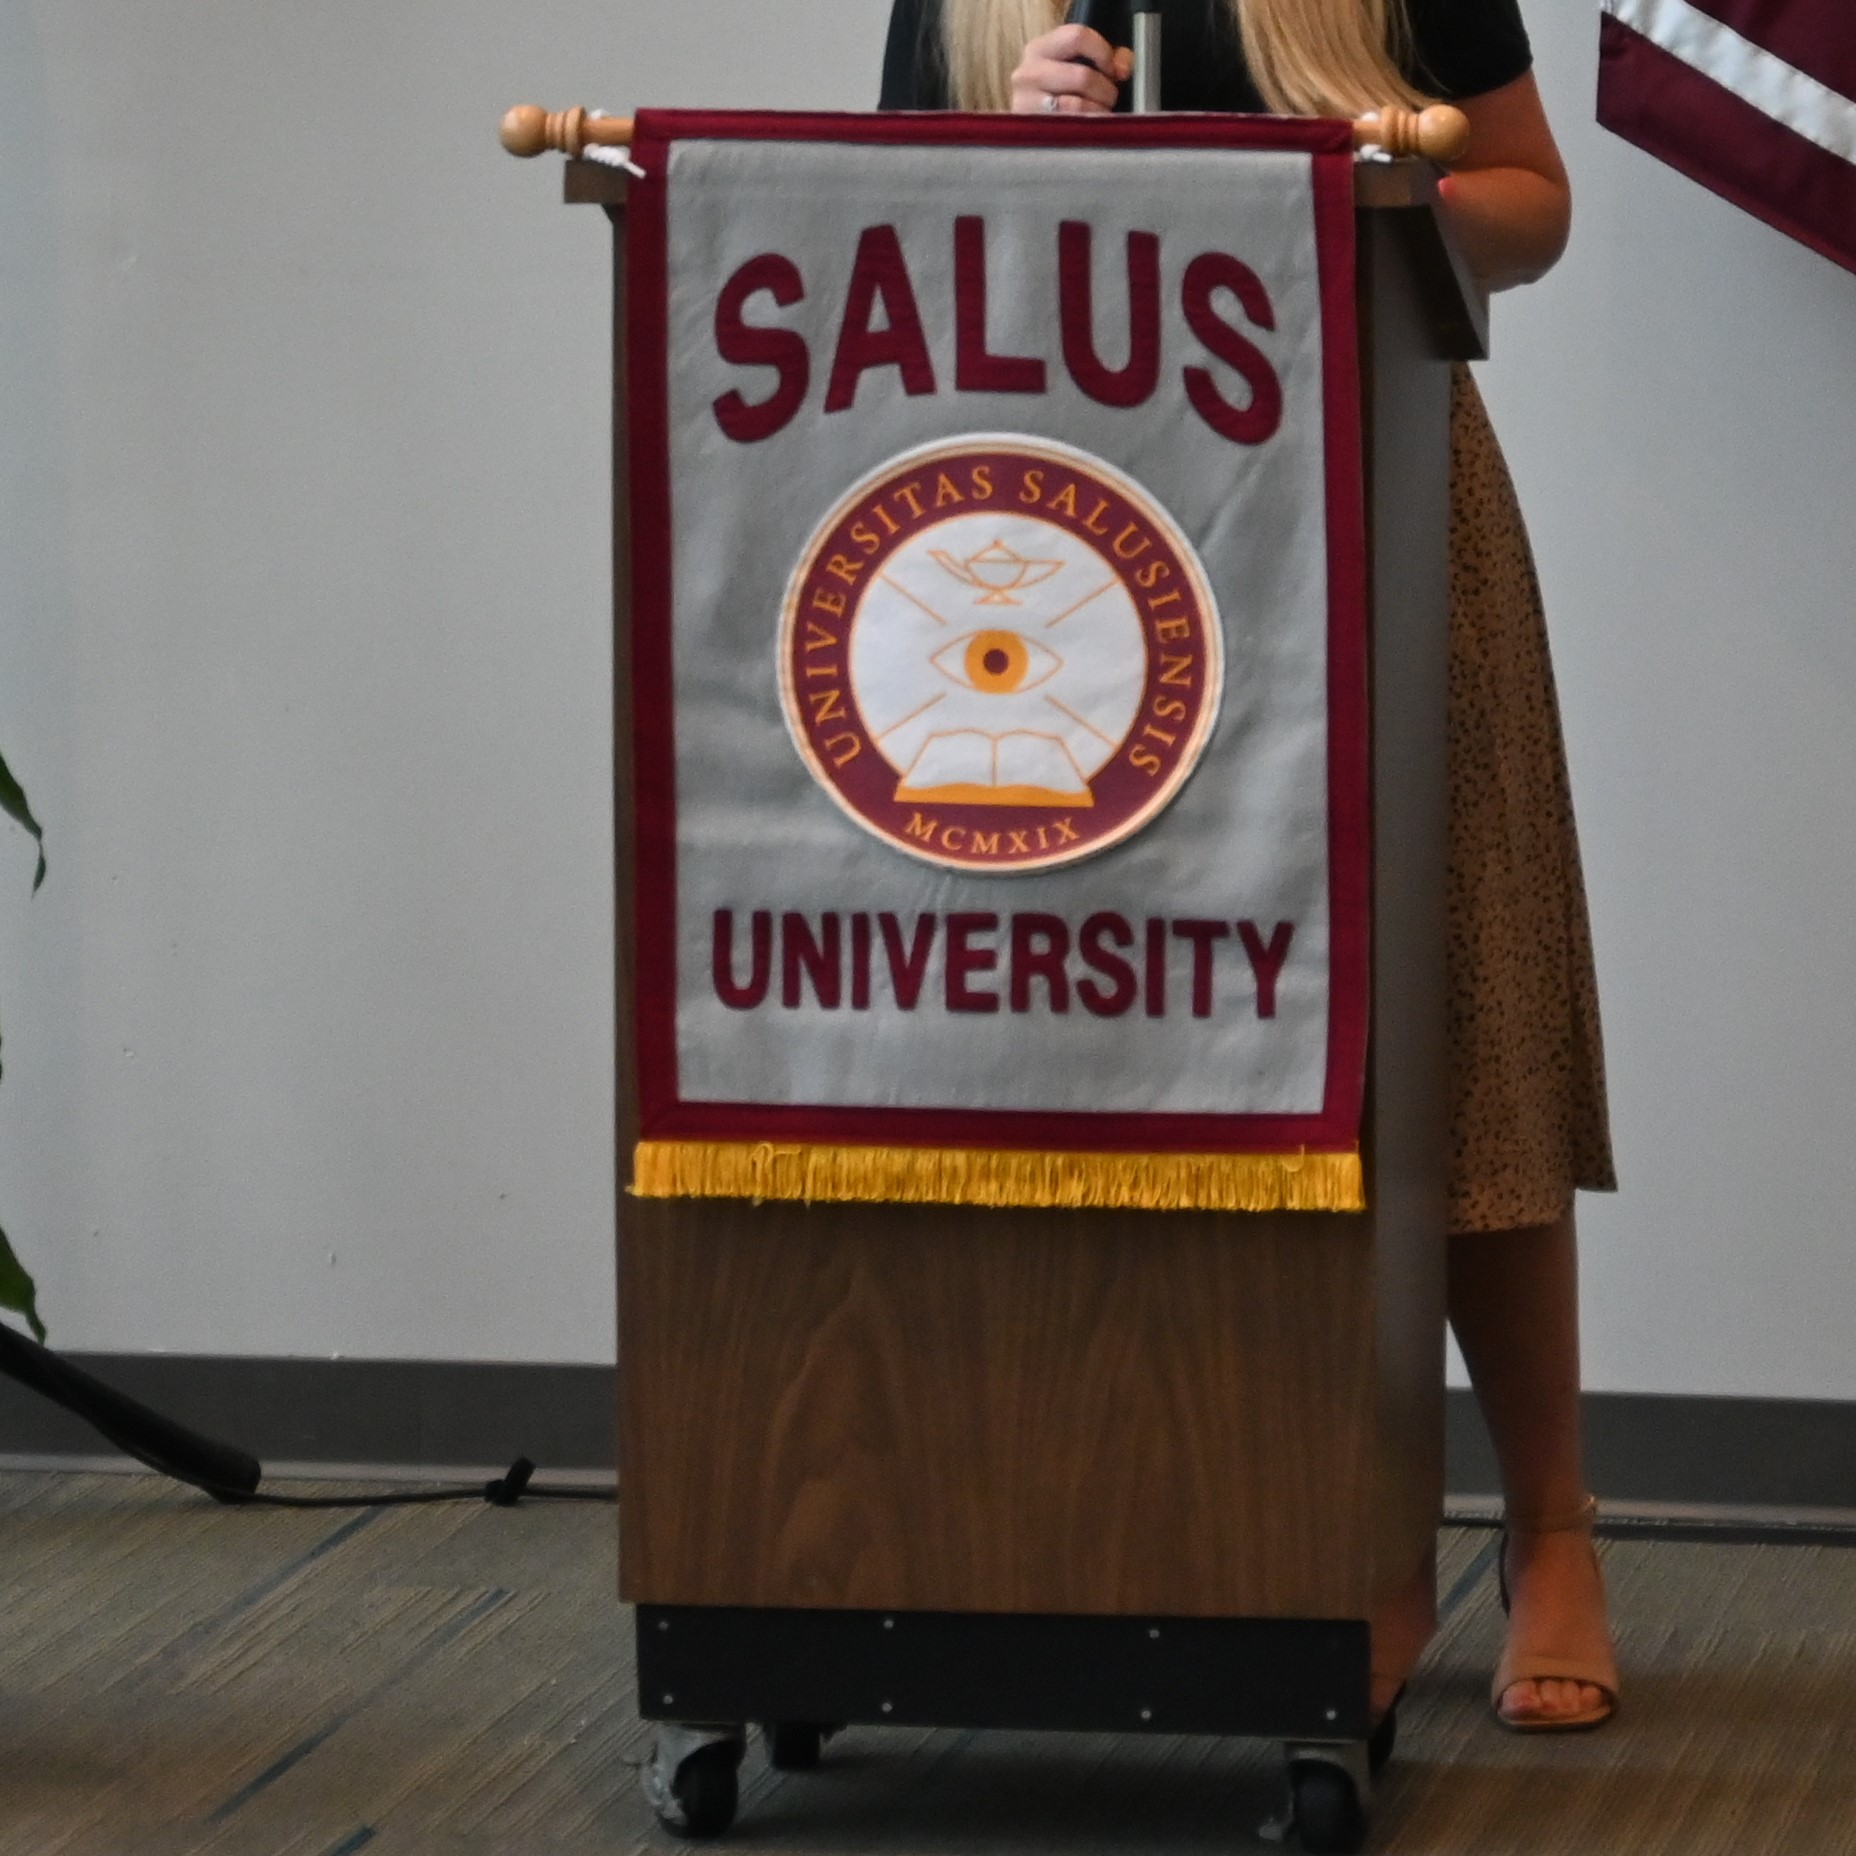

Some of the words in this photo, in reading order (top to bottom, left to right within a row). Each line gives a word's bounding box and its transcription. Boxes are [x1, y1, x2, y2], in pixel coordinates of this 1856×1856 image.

[710, 215, 1283, 444] SALUS
[803, 465, 993, 772] UNIVERSITAS
[1017, 468, 1191, 778] SALUSIENSIS
[904, 812, 1080, 856] MCMXIX
[711, 909, 1294, 1020] UNIVERSITY
